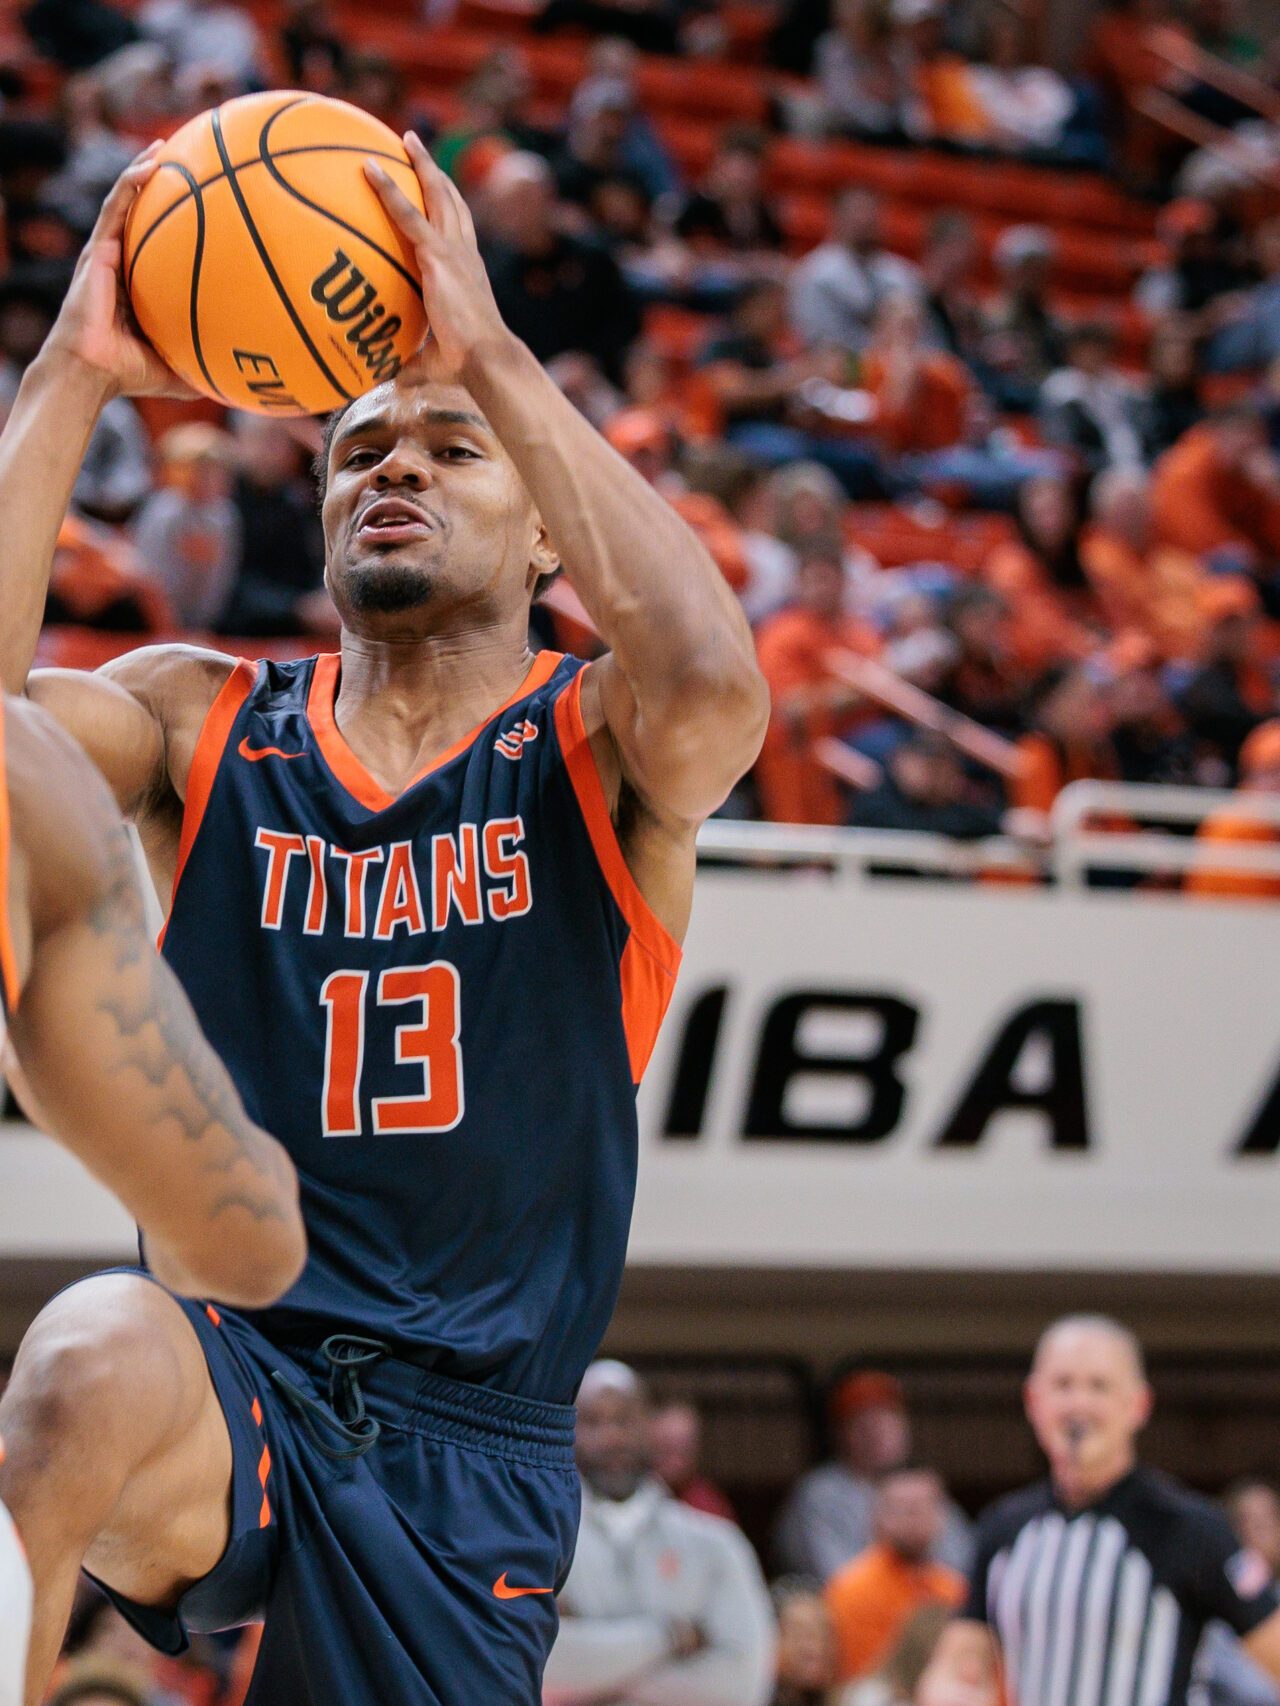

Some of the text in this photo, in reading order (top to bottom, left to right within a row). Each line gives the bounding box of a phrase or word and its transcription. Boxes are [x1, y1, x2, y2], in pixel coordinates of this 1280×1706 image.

[310, 247, 402, 380] Wilso
[254, 815, 534, 940] TITANS
[320, 959, 466, 1138] 13
